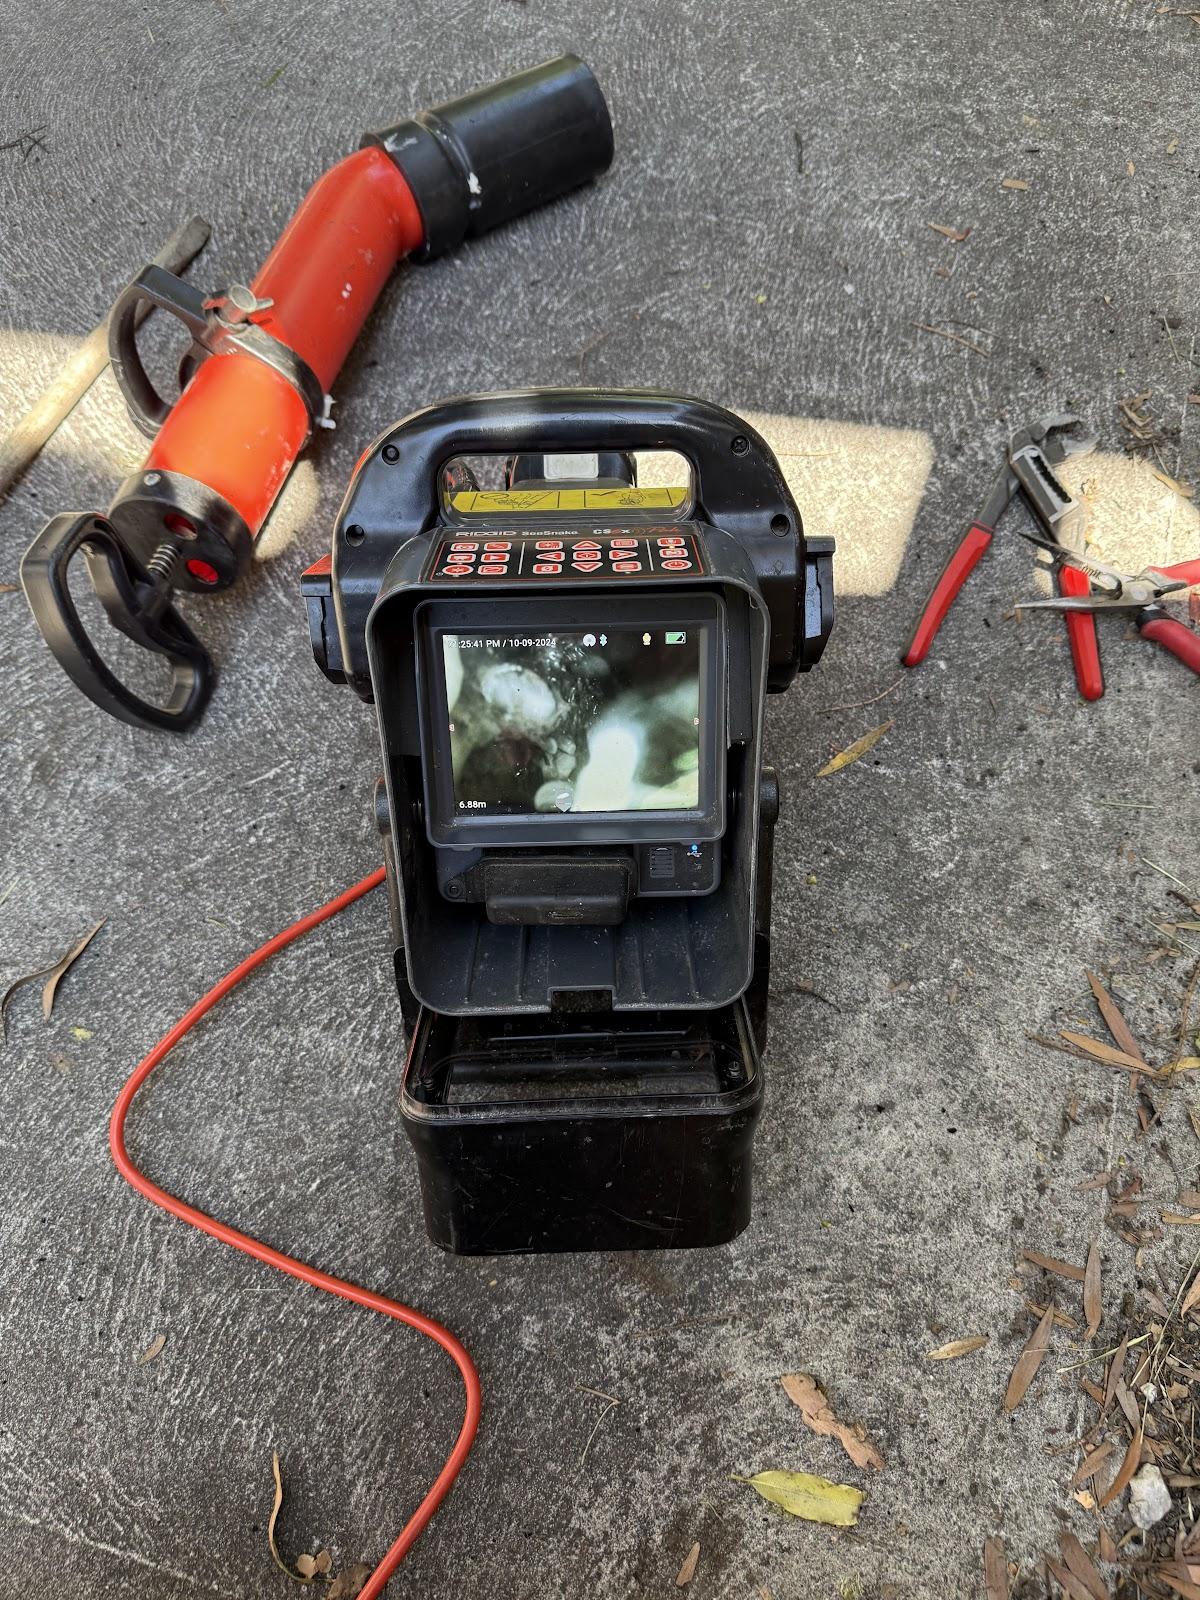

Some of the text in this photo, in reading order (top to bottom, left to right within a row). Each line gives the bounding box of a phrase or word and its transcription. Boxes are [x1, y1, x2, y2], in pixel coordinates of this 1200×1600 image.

[486, 639, 500, 648] PM
[509, 638, 557, 648] 10-09-2024
[459, 800, 487, 809] 6.88m
